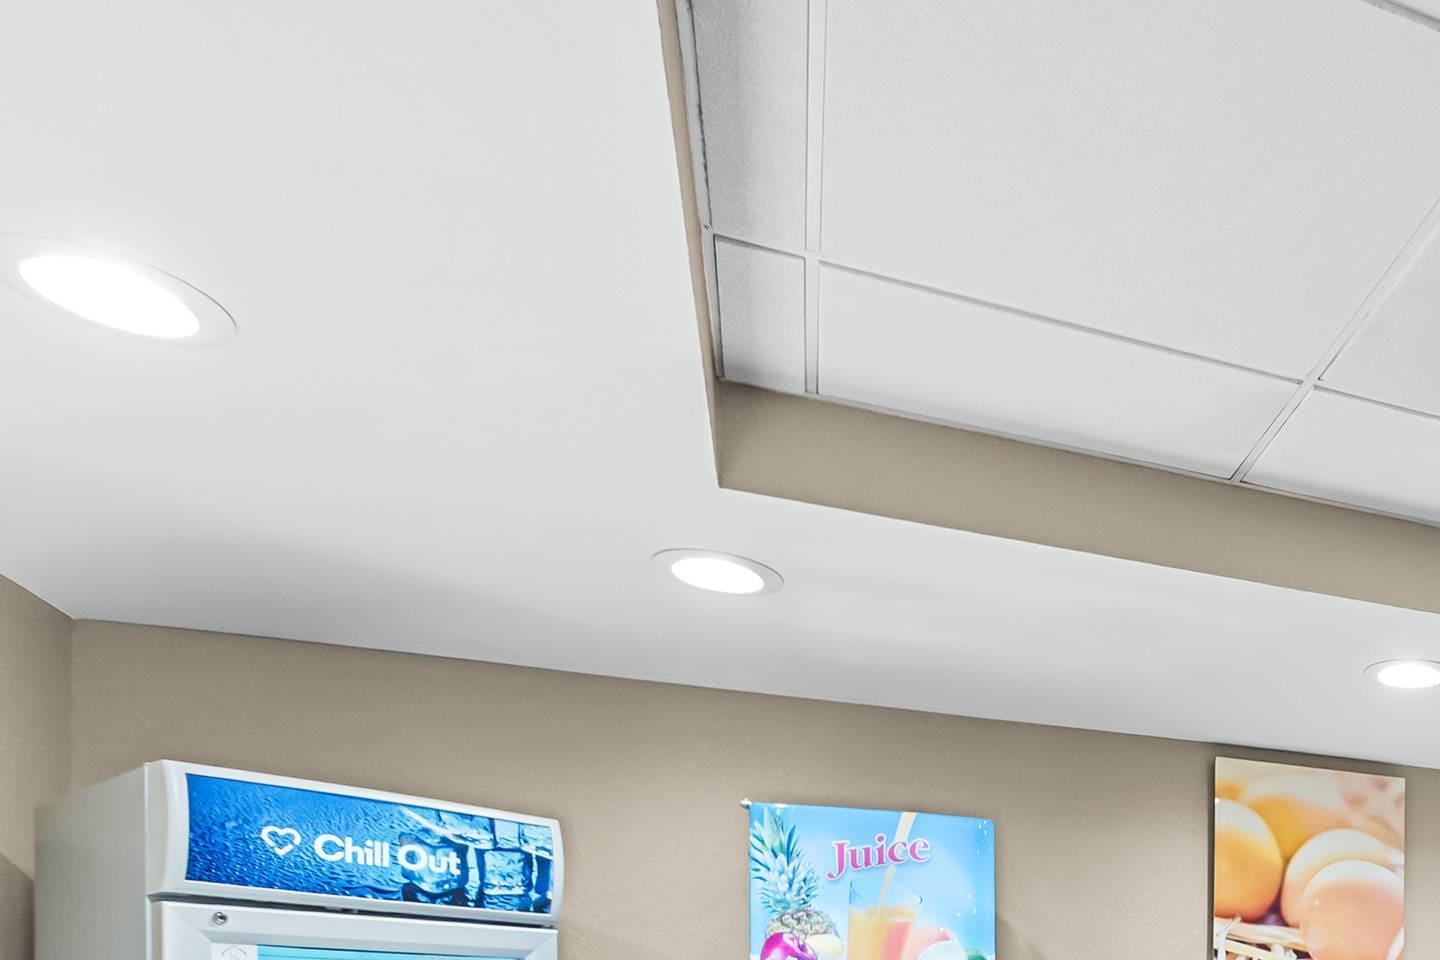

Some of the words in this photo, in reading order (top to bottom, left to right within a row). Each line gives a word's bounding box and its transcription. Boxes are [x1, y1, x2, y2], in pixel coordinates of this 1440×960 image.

[313, 834, 390, 867] Chill
[397, 844, 461, 876] Out
[826, 834, 930, 880] Juice
